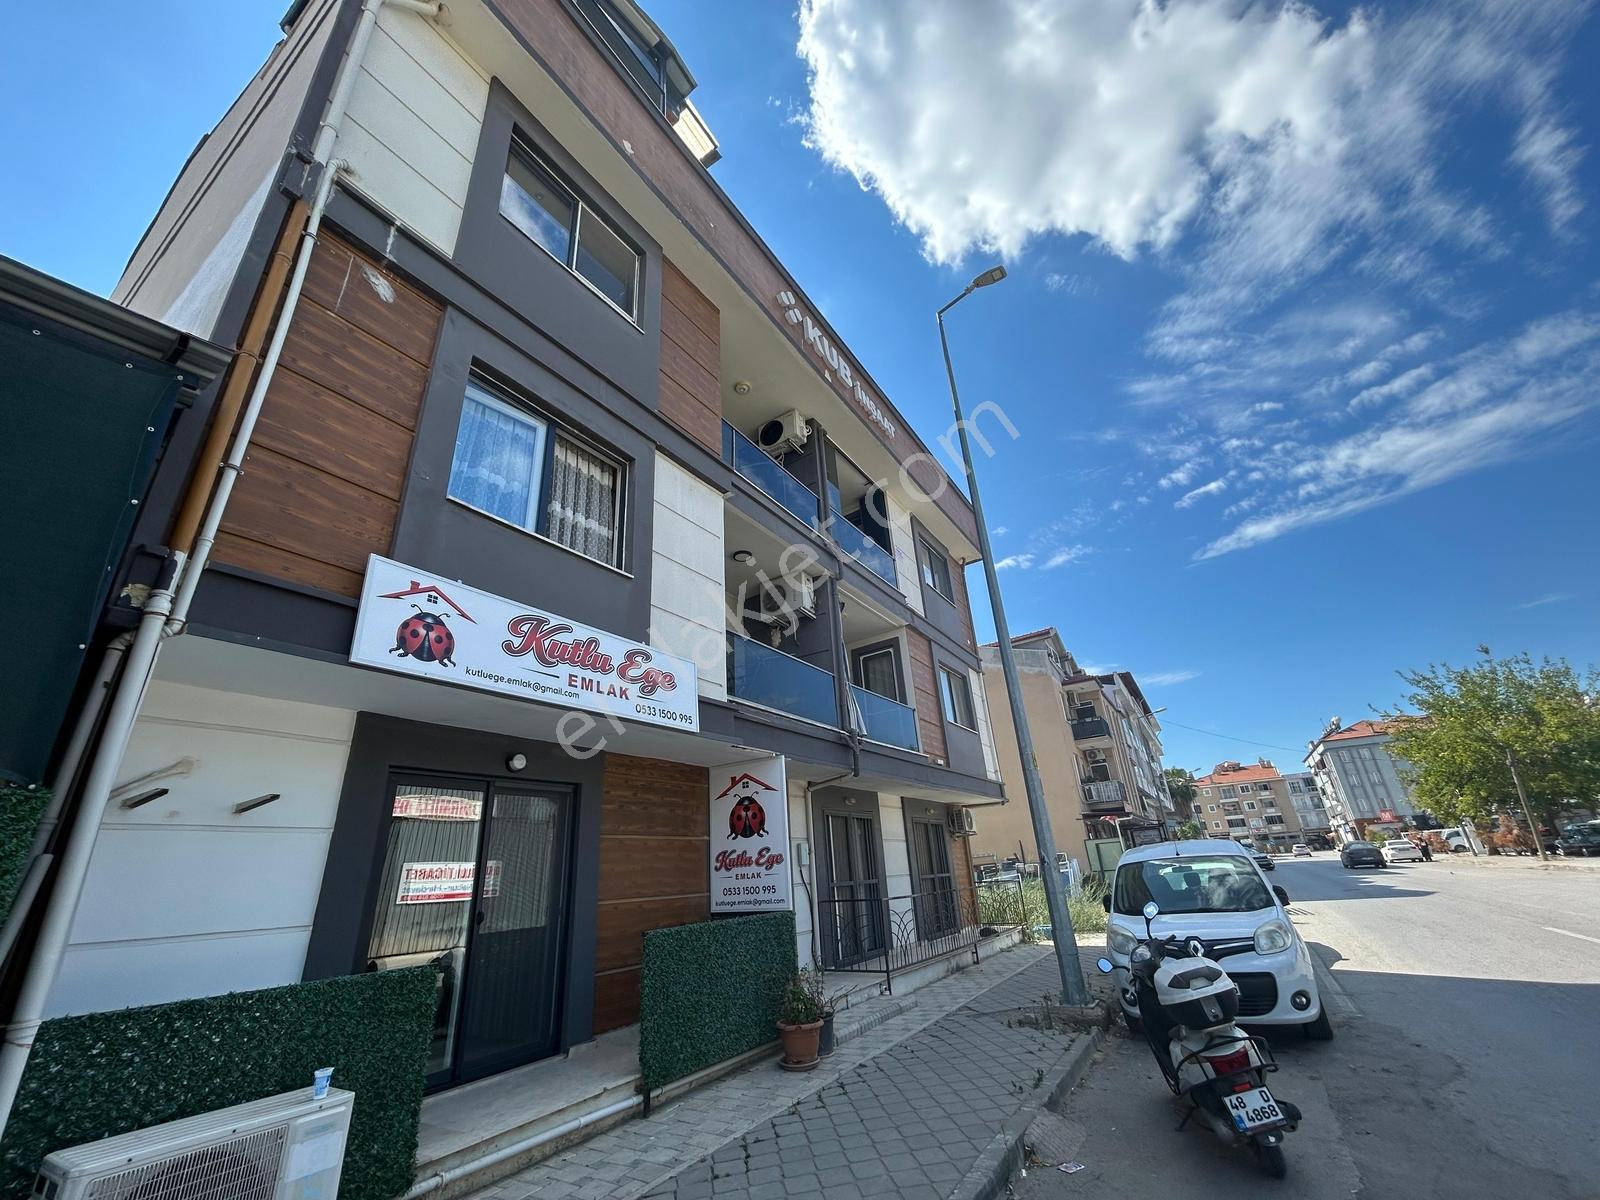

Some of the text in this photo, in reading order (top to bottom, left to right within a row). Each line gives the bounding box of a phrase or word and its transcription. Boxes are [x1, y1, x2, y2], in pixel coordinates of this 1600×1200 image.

[803, 316, 853, 388] KUB
[502, 615, 678, 696] Kutlu Ege
[465, 666, 580, 699] kutluege.emlak@gmail.com
[568, 673, 630, 700] EMLAK
[635, 703, 693, 725] 0533 1500 995
[714, 846, 784, 872] Kutlu Ege
[735, 872, 762, 880] EMLAK
[722, 885, 776, 896] 0533 1500 995
[1229, 1096, 1247, 1111] 48
[1245, 1104, 1279, 1123] 4868
